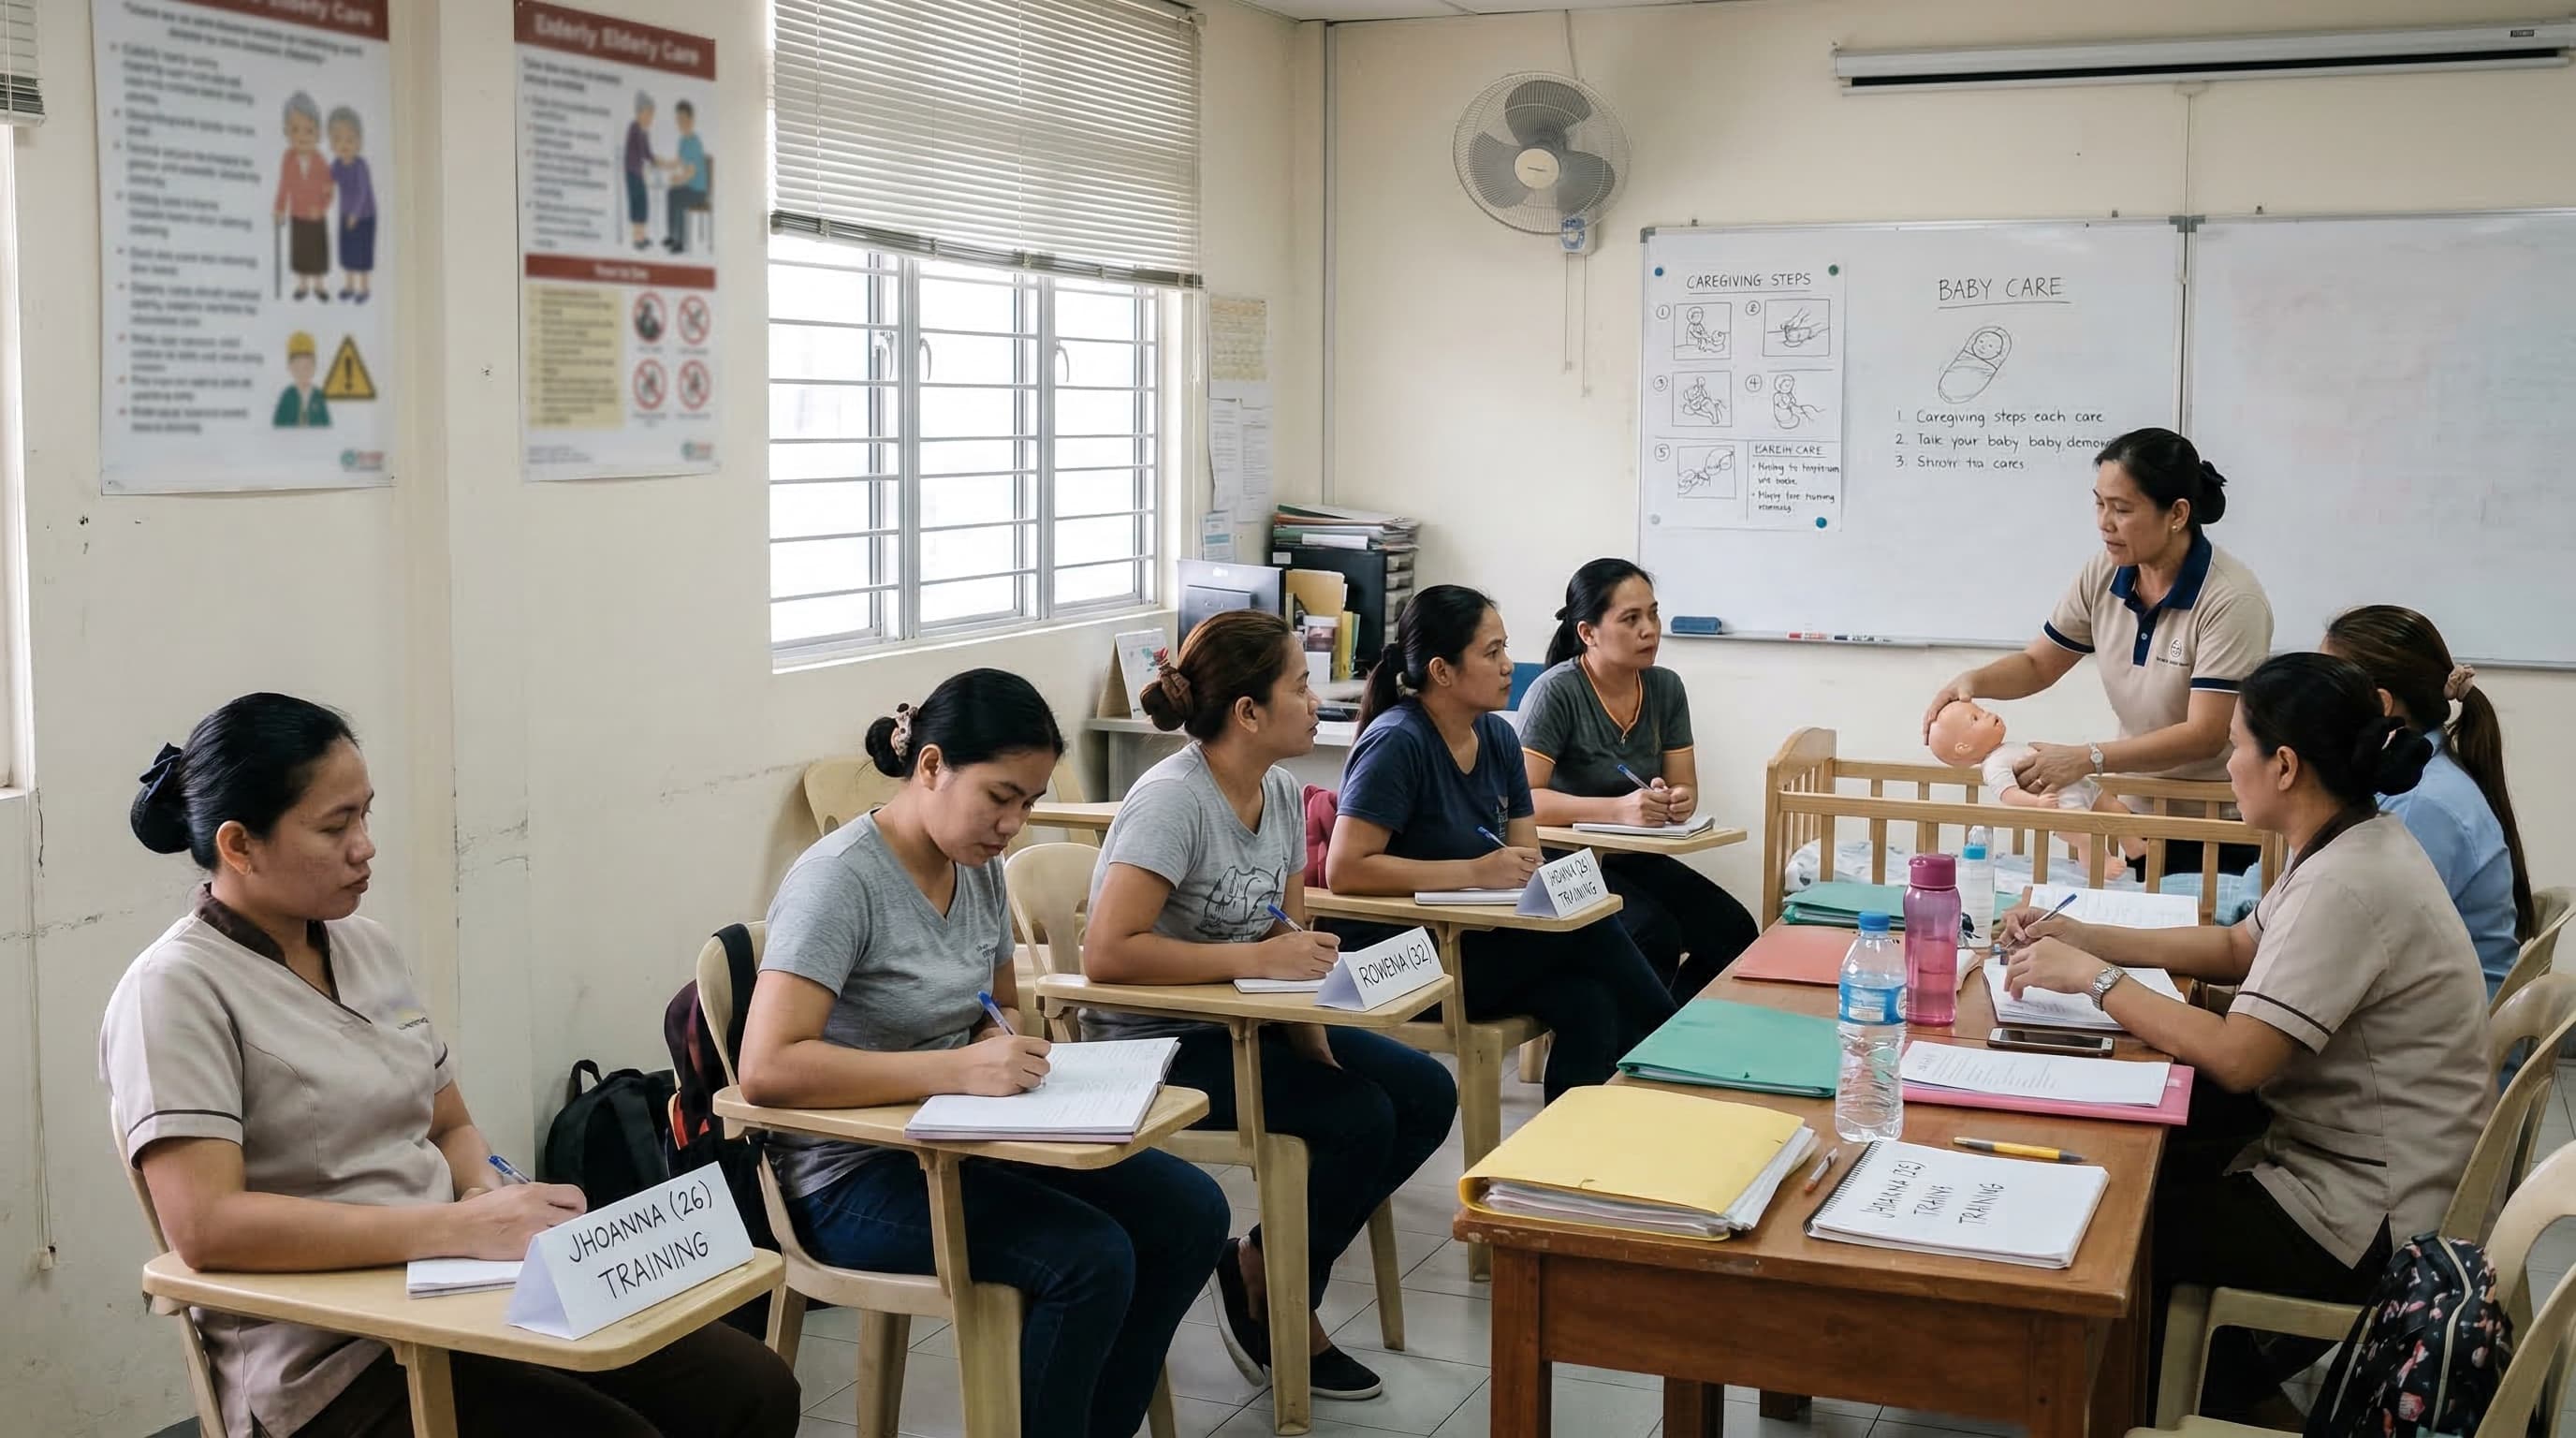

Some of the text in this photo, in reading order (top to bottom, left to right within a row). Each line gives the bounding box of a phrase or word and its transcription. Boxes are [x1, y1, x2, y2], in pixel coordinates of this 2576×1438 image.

[1687, 272, 1812, 289] CAREGIVING STEPS
[1939, 277, 2064, 301] BABY CARE
[1917, 409, 1985, 428] Caregiving
[1995, 409, 2027, 426] steps
[2034, 409, 2066, 422] each
[2075, 413, 2105, 423] care
[1795, 445, 1822, 456] CARE
[1951, 436, 1978, 450] your
[1988, 434, 2019, 454] baby
[1358, 937, 1432, 989] ROWENA (32)
[569, 1180, 713, 1263] JHOANNA (26)
[597, 1231, 710, 1299] TRAINING
